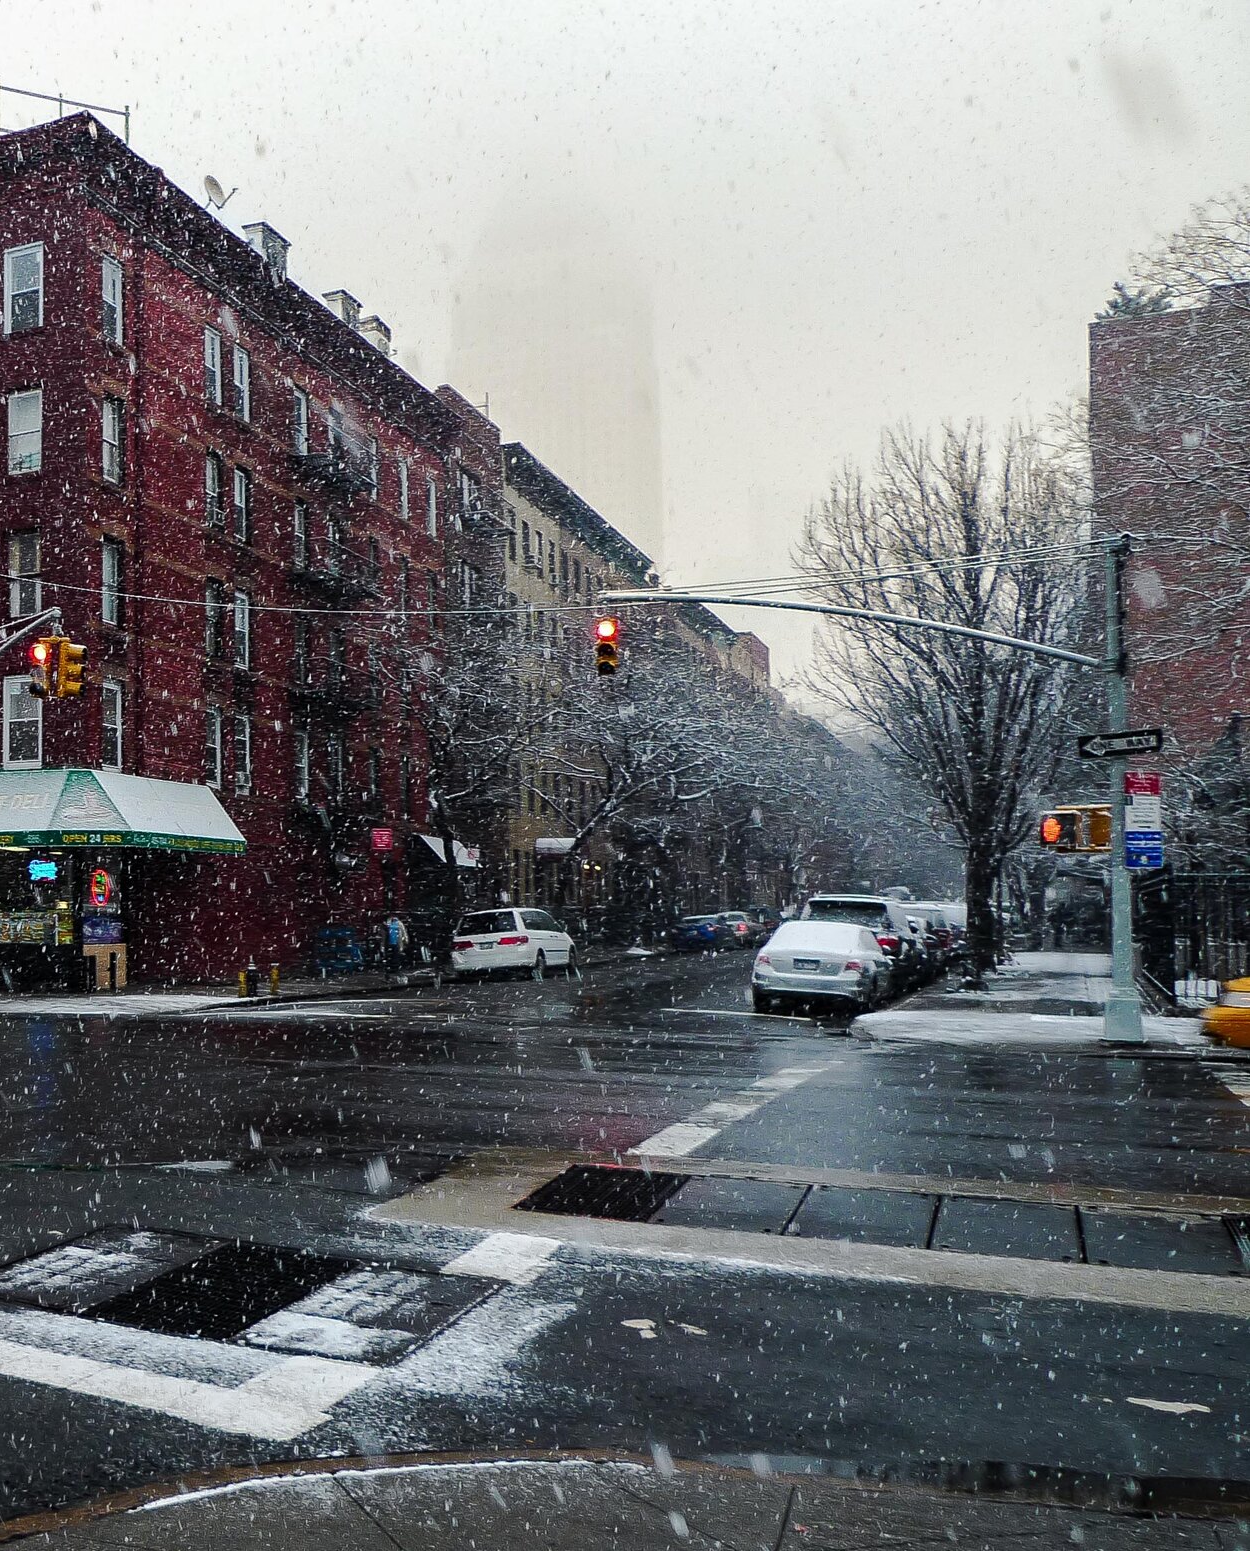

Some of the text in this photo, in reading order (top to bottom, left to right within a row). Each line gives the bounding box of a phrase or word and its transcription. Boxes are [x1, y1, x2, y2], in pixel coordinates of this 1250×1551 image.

[1090, 736, 1153, 751] ONE WAY
[10, 793, 49, 811] DELI
[62, 834, 87, 844] OPEN
[89, 834, 101, 843] 24
[103, 834, 123, 844] HRS
